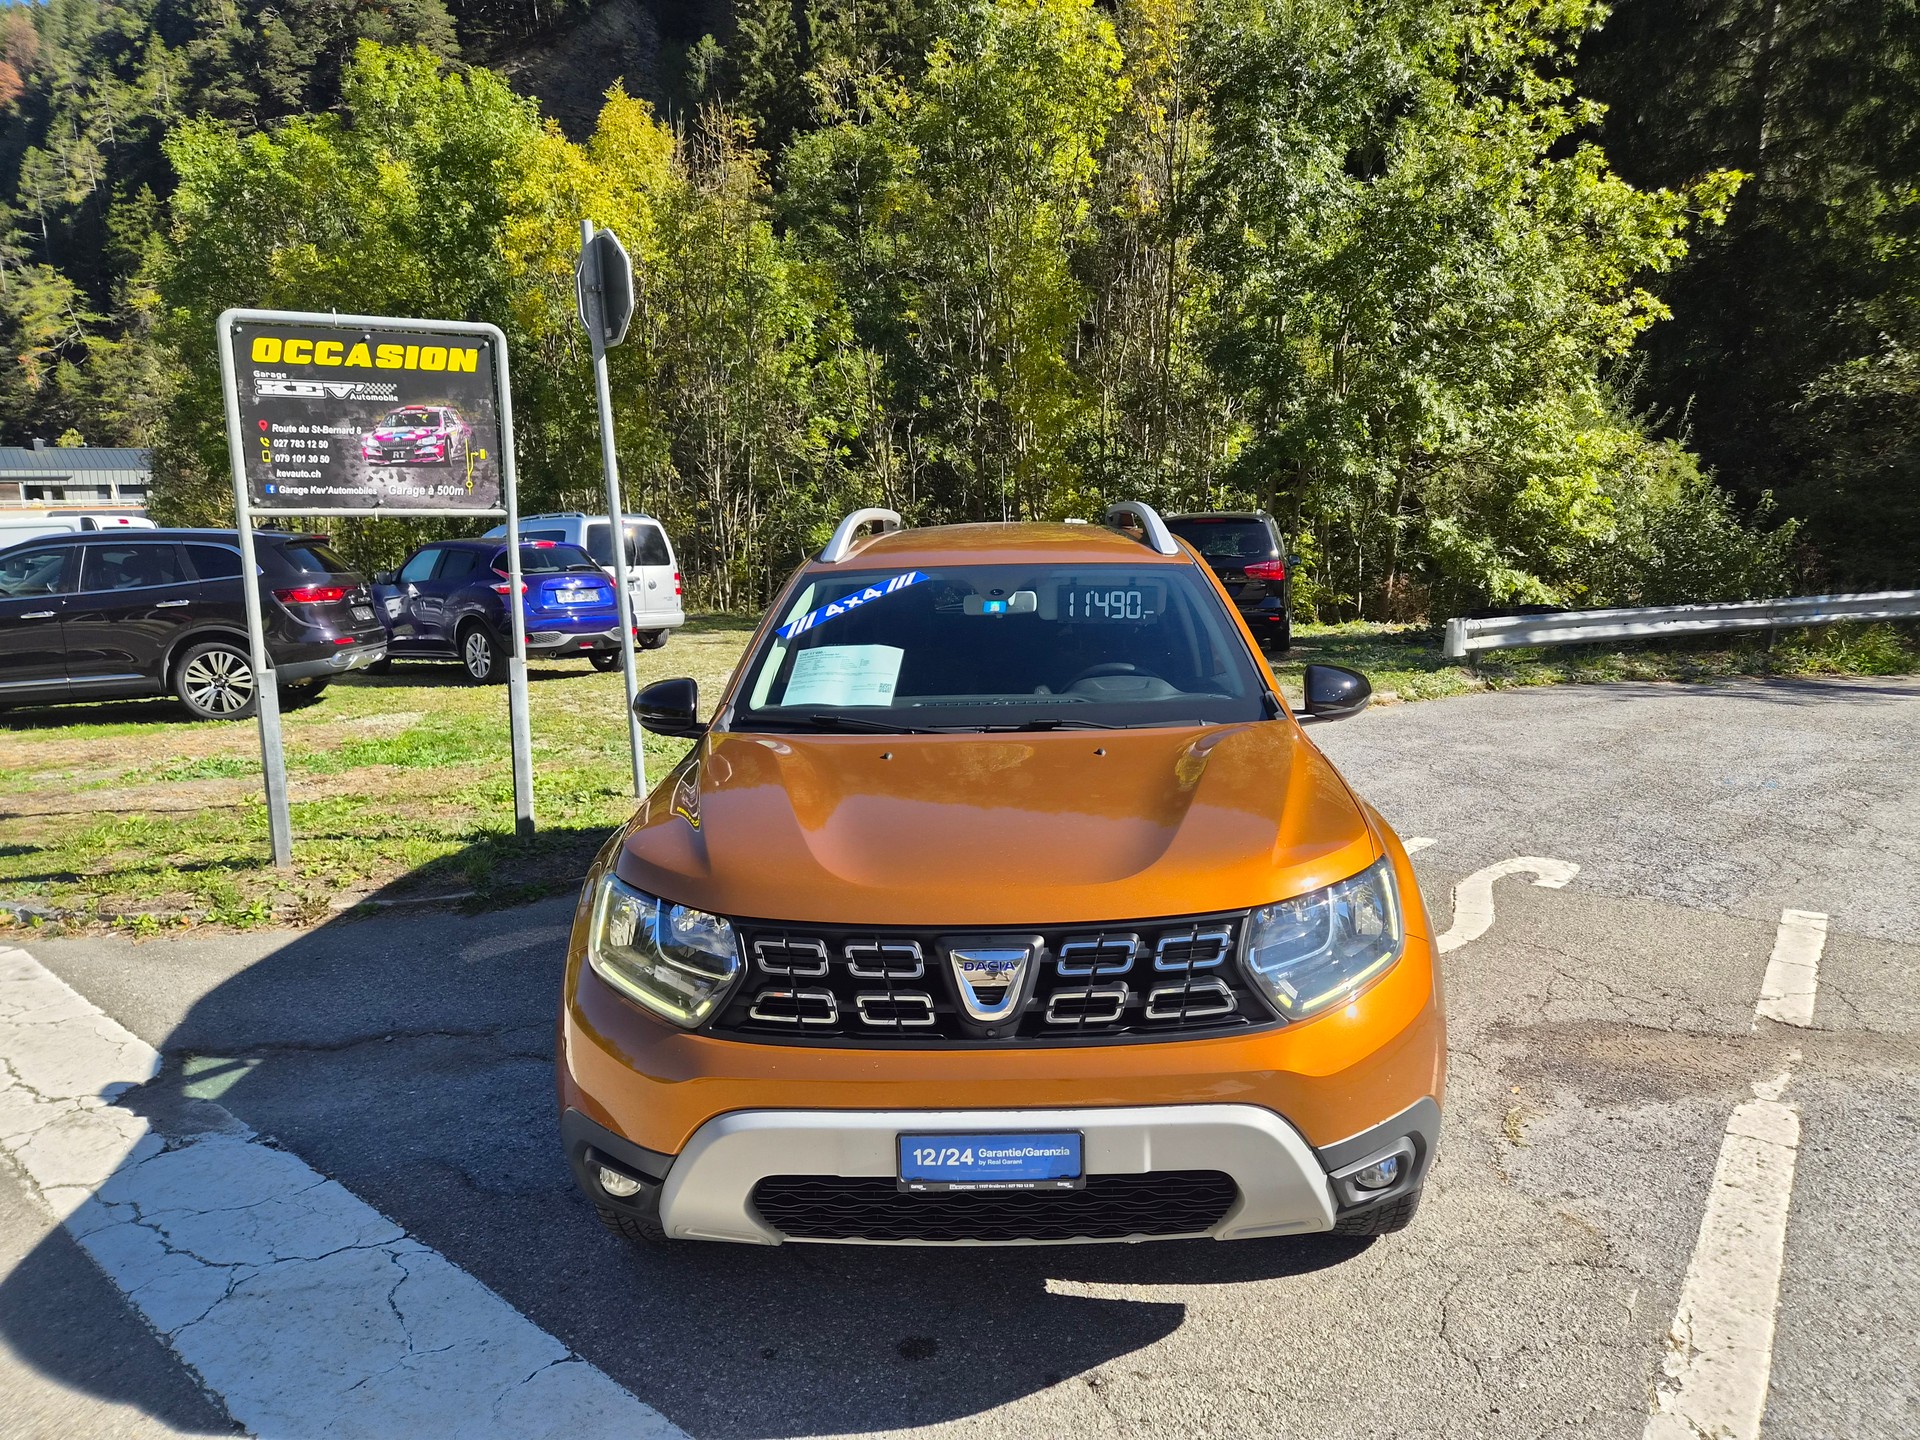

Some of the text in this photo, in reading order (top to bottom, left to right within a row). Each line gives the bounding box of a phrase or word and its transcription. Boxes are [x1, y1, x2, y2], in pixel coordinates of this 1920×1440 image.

[251, 337, 479, 373] OCCASION
[253, 370, 287, 379] Garage
[350, 393, 399, 402] Automobile
[272, 423, 362, 435] Route du St-Bernard 8
[273, 439, 328, 449] 027 783 12 50
[274, 454, 330, 464] 079 101 30 50
[392, 451, 405, 459] RT
[276, 469, 321, 478] kevauto.ch
[279, 485, 377, 495] Garage Kev'Automobiles
[388, 485, 464, 496] Garage à 500m
[963, 961, 1015, 972] DACIA
[913, 1147, 1070, 1166] 12/24 Garantie/Garanzia
